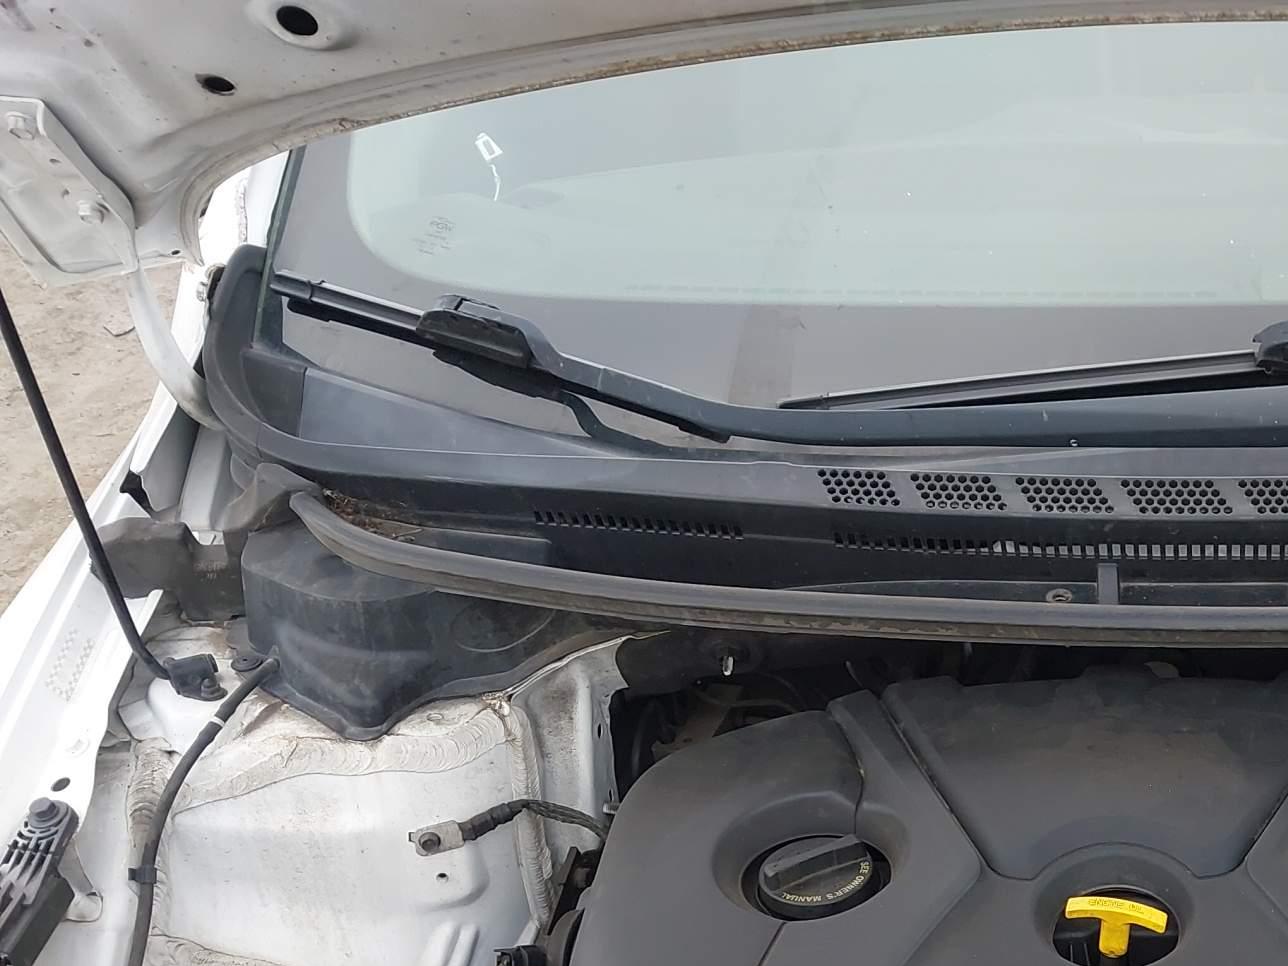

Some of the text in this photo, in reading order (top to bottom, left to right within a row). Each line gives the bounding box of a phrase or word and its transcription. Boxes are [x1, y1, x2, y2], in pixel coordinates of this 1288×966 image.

[782, 861, 870, 902] SEE OWNER'S MANUAL
